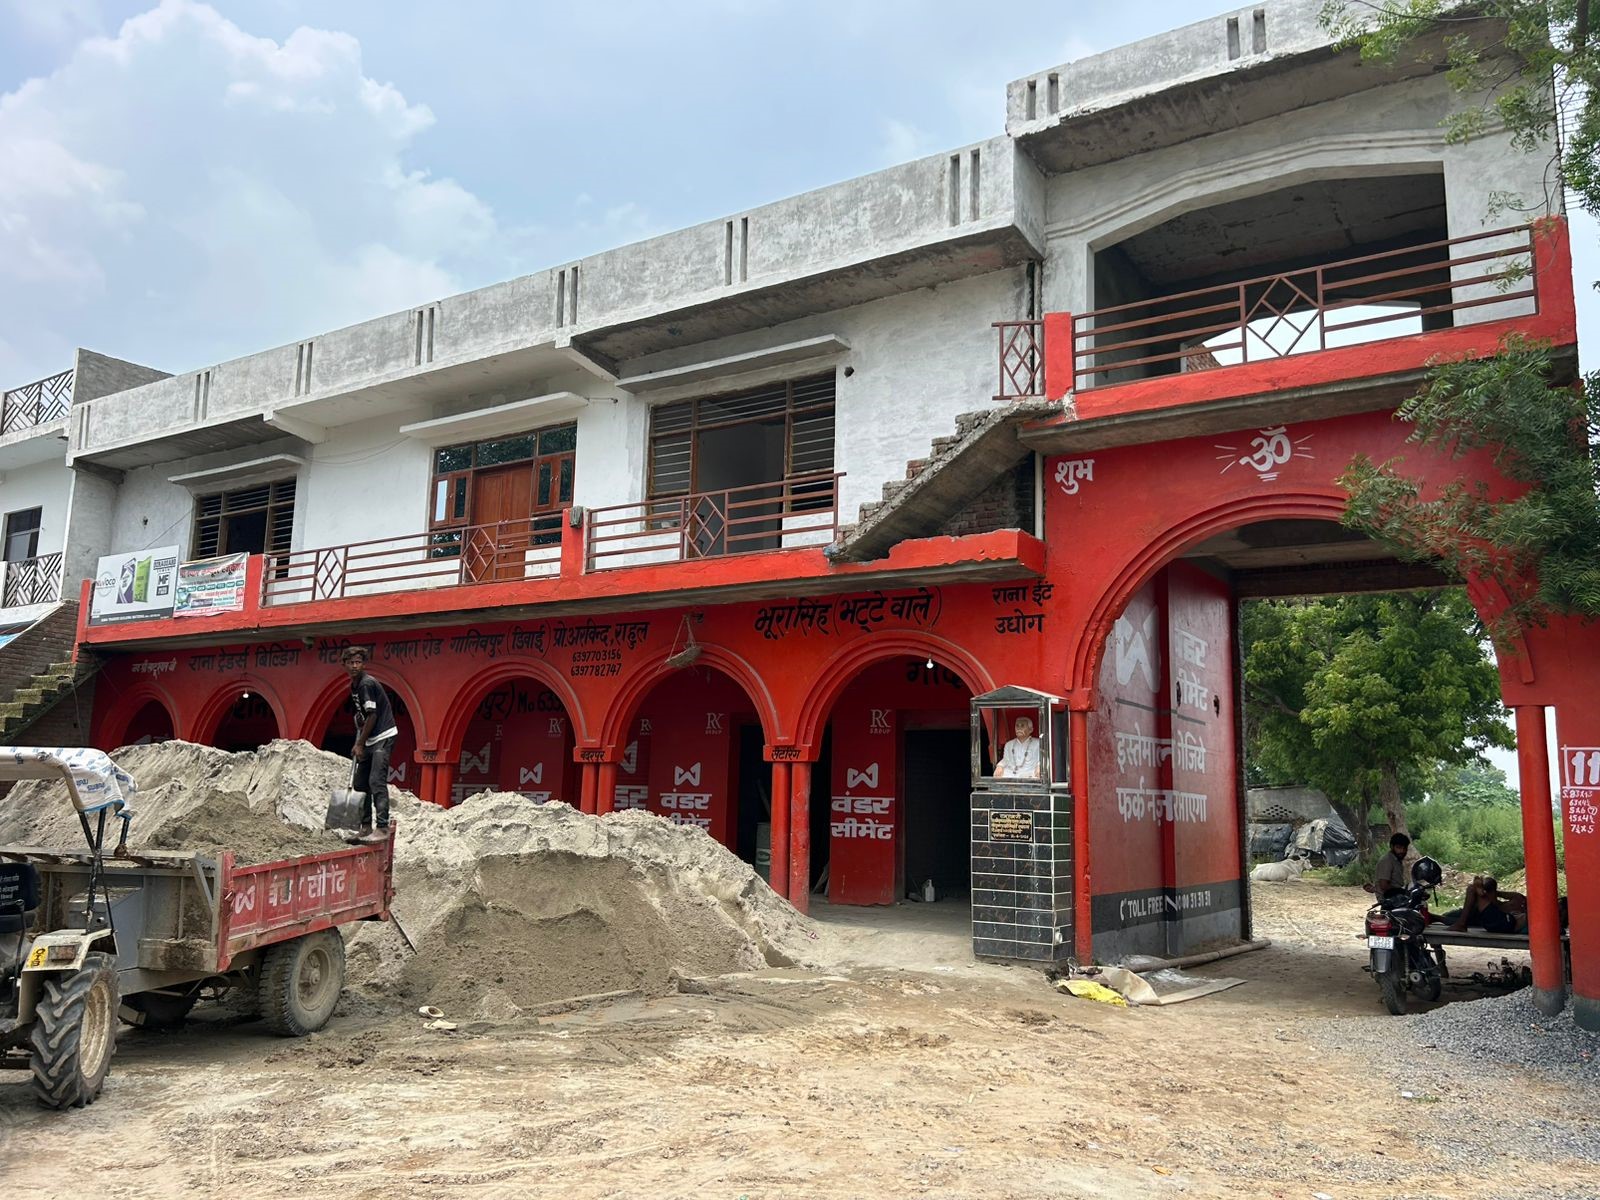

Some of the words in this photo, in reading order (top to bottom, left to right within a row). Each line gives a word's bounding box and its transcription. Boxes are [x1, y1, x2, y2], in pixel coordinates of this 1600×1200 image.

[1053, 458, 1095, 495] शुभ
[992, 585, 1029, 606] राना
[754, 605, 795, 640] भूरा
[794, 597, 832, 637] सिंह
[890, 586, 942, 629] वाले)
[188, 654, 217, 673] राना
[217, 645, 251, 673] ट्रेडर्स
[254, 642, 302, 668] बिल्डिंग
[614, 621, 651, 651] राहुल
[570, 662, 622, 677] 6397782747
[706, 712, 725, 730] RK
[869, 708, 892, 728] RK
[659, 787, 712, 810] वंडर
[831, 790, 896, 815] वंडर
[1115, 776, 1145, 824] फर्क
[831, 817, 895, 841] सीमेंट
[1127, 899, 1147, 918] TOLL
[1147, 895, 1164, 916] FREE
